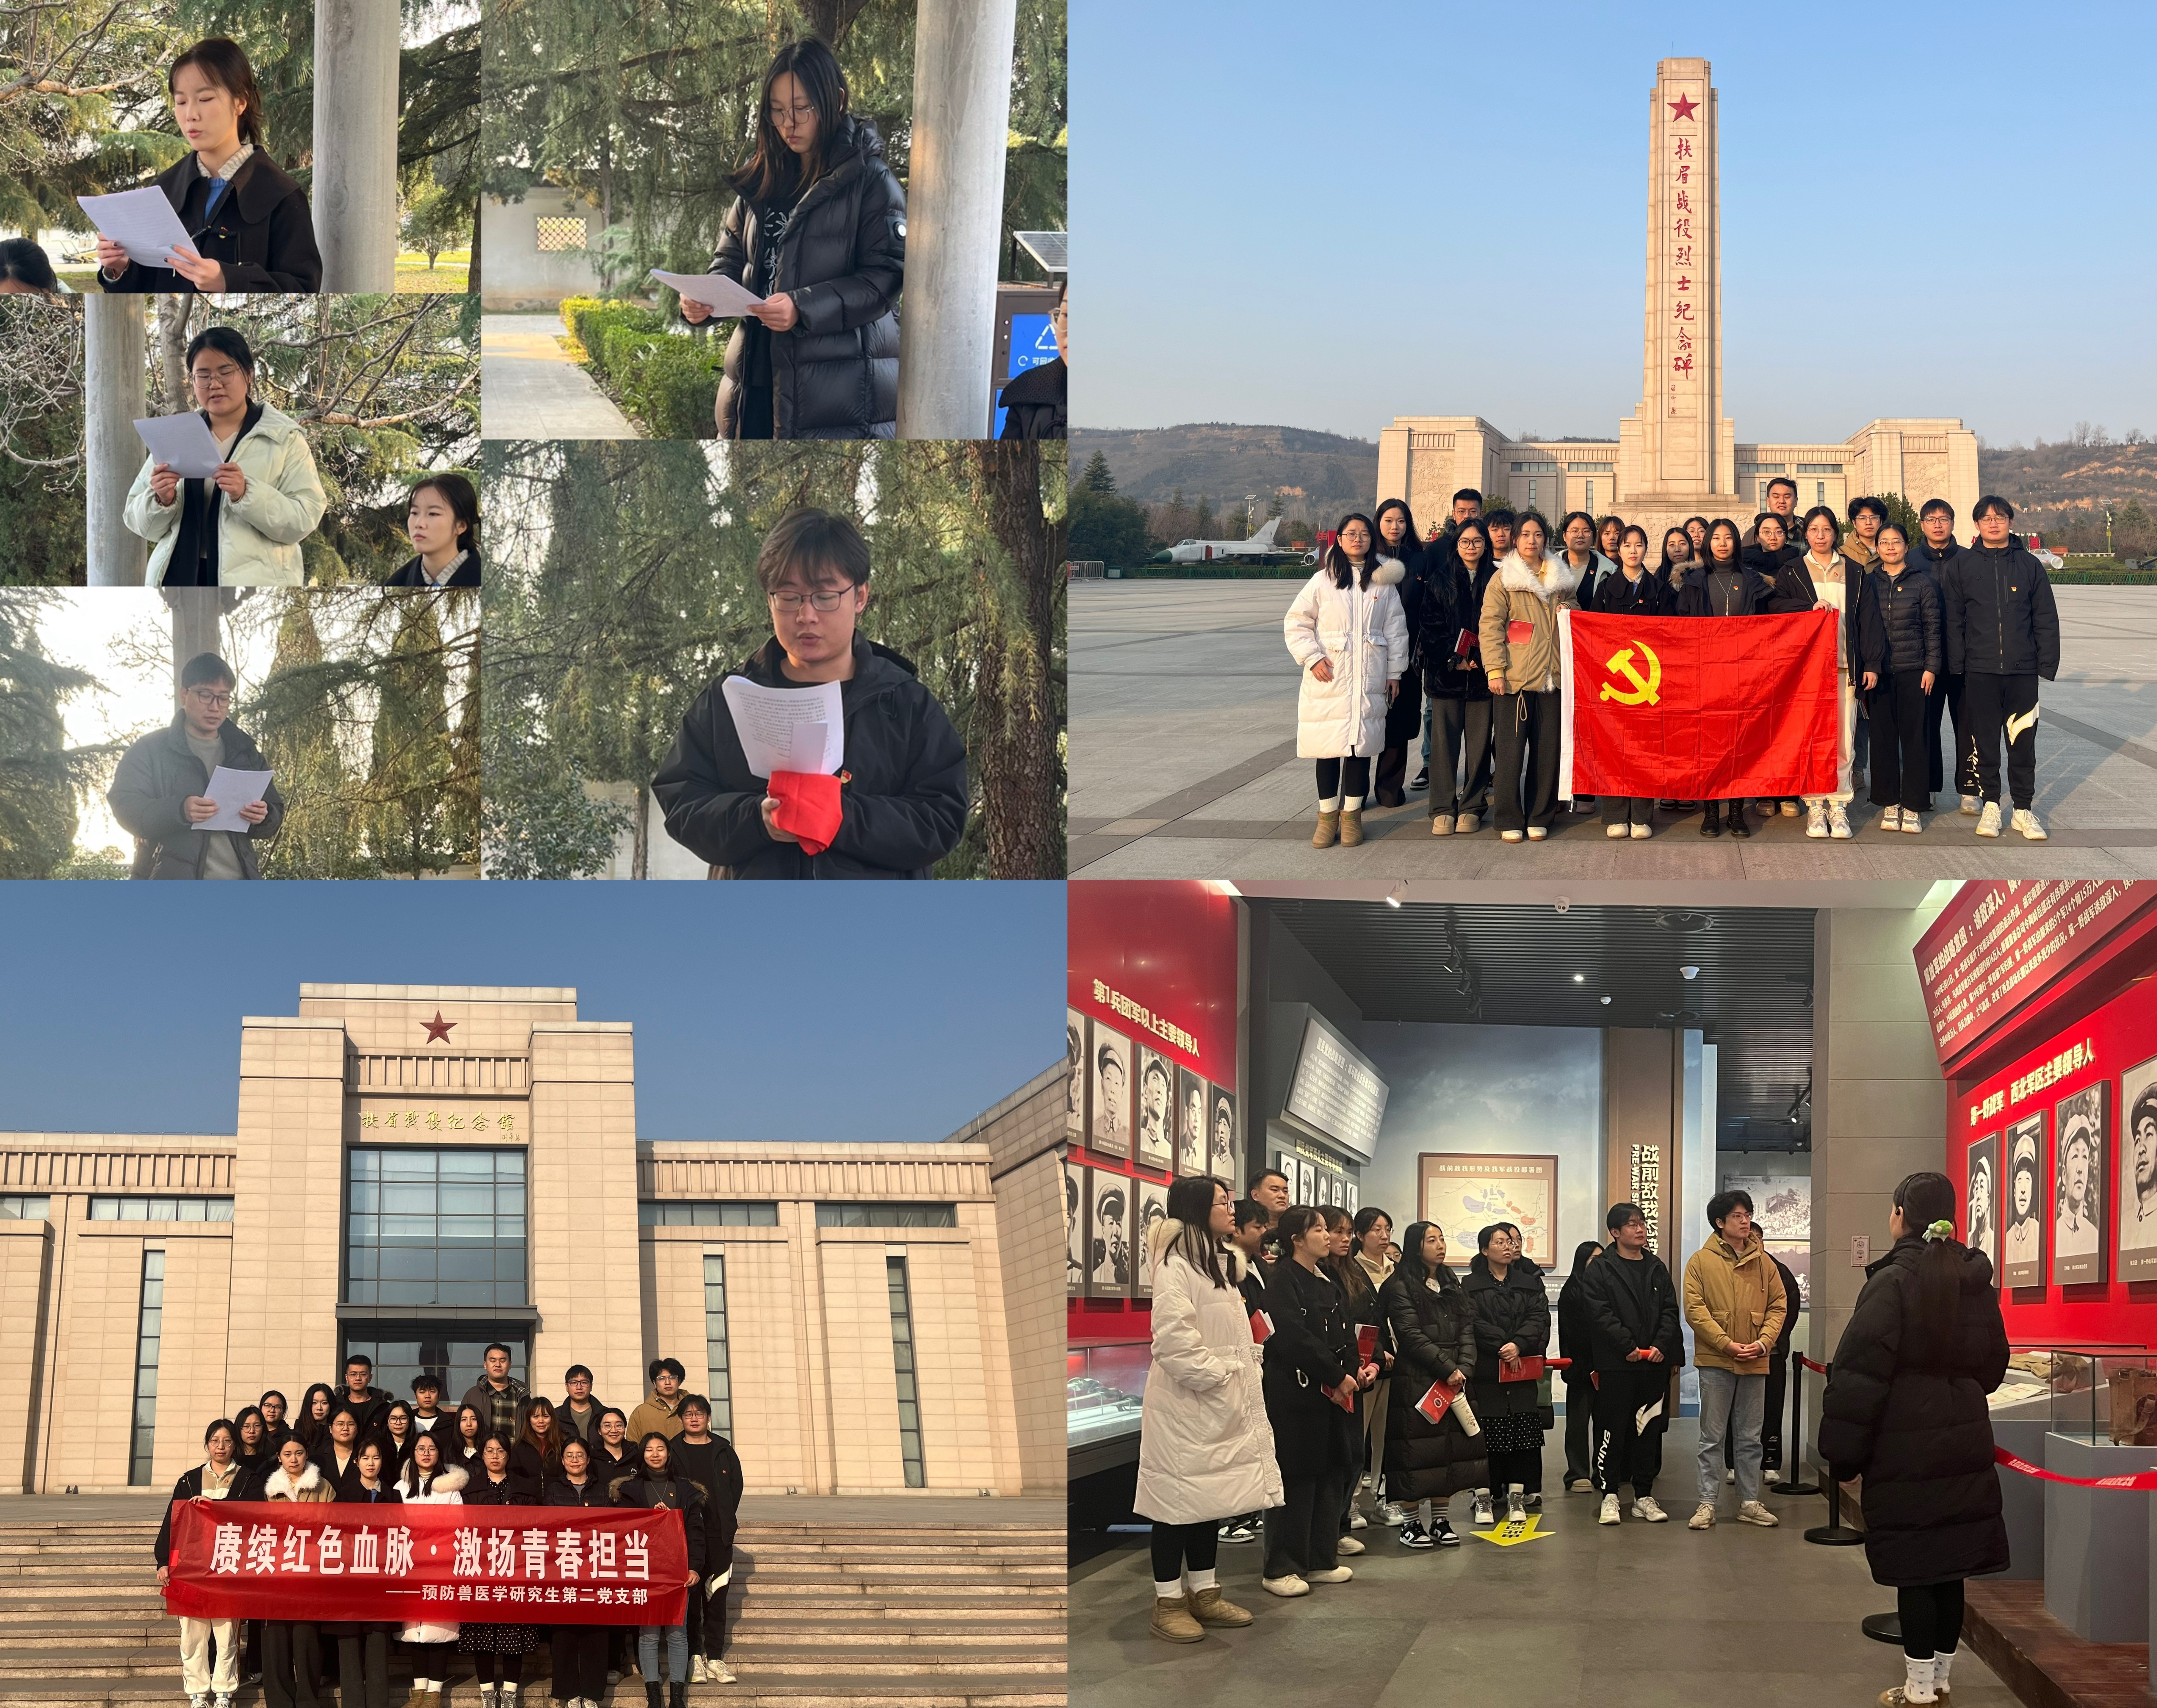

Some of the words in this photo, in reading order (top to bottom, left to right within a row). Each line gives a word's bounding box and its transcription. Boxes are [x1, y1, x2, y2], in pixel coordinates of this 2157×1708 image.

[1673, 137, 1695, 380] 扶眉战役烈士纪念碑
[1032, 357, 1057, 365] 可回
[1971, 1090, 2005, 1126] 第一野战军
[2011, 1037, 2096, 1106] 西北军区主要领导人
[1439, 1165, 1543, 1173] 战前敌我形势及我军战役部署图
[1631, 1144, 1640, 1190] PRE-WAR
